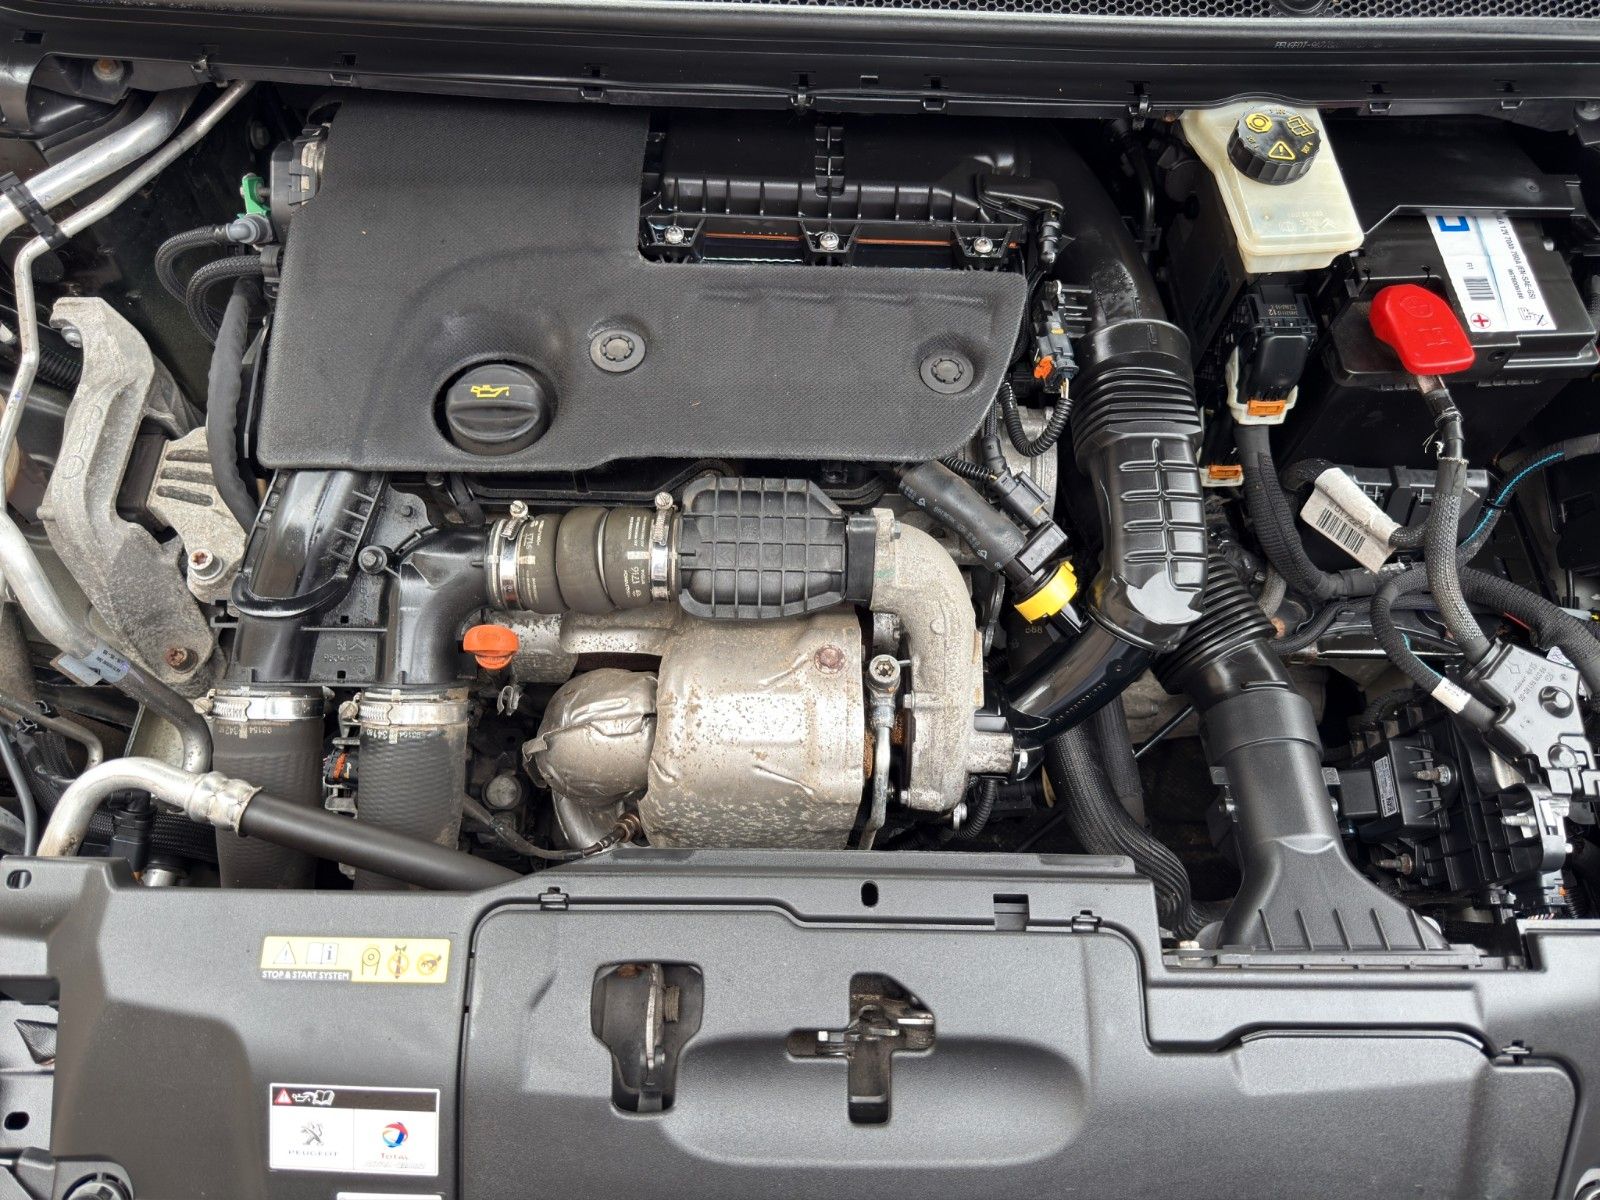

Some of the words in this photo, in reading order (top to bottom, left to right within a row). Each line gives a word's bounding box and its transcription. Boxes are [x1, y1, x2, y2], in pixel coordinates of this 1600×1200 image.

[262, 970, 283, 979] STOP
[292, 971, 318, 980] START
[319, 972, 349, 980] SYSTEM
[288, 1150, 338, 1158] PEUGEOT
